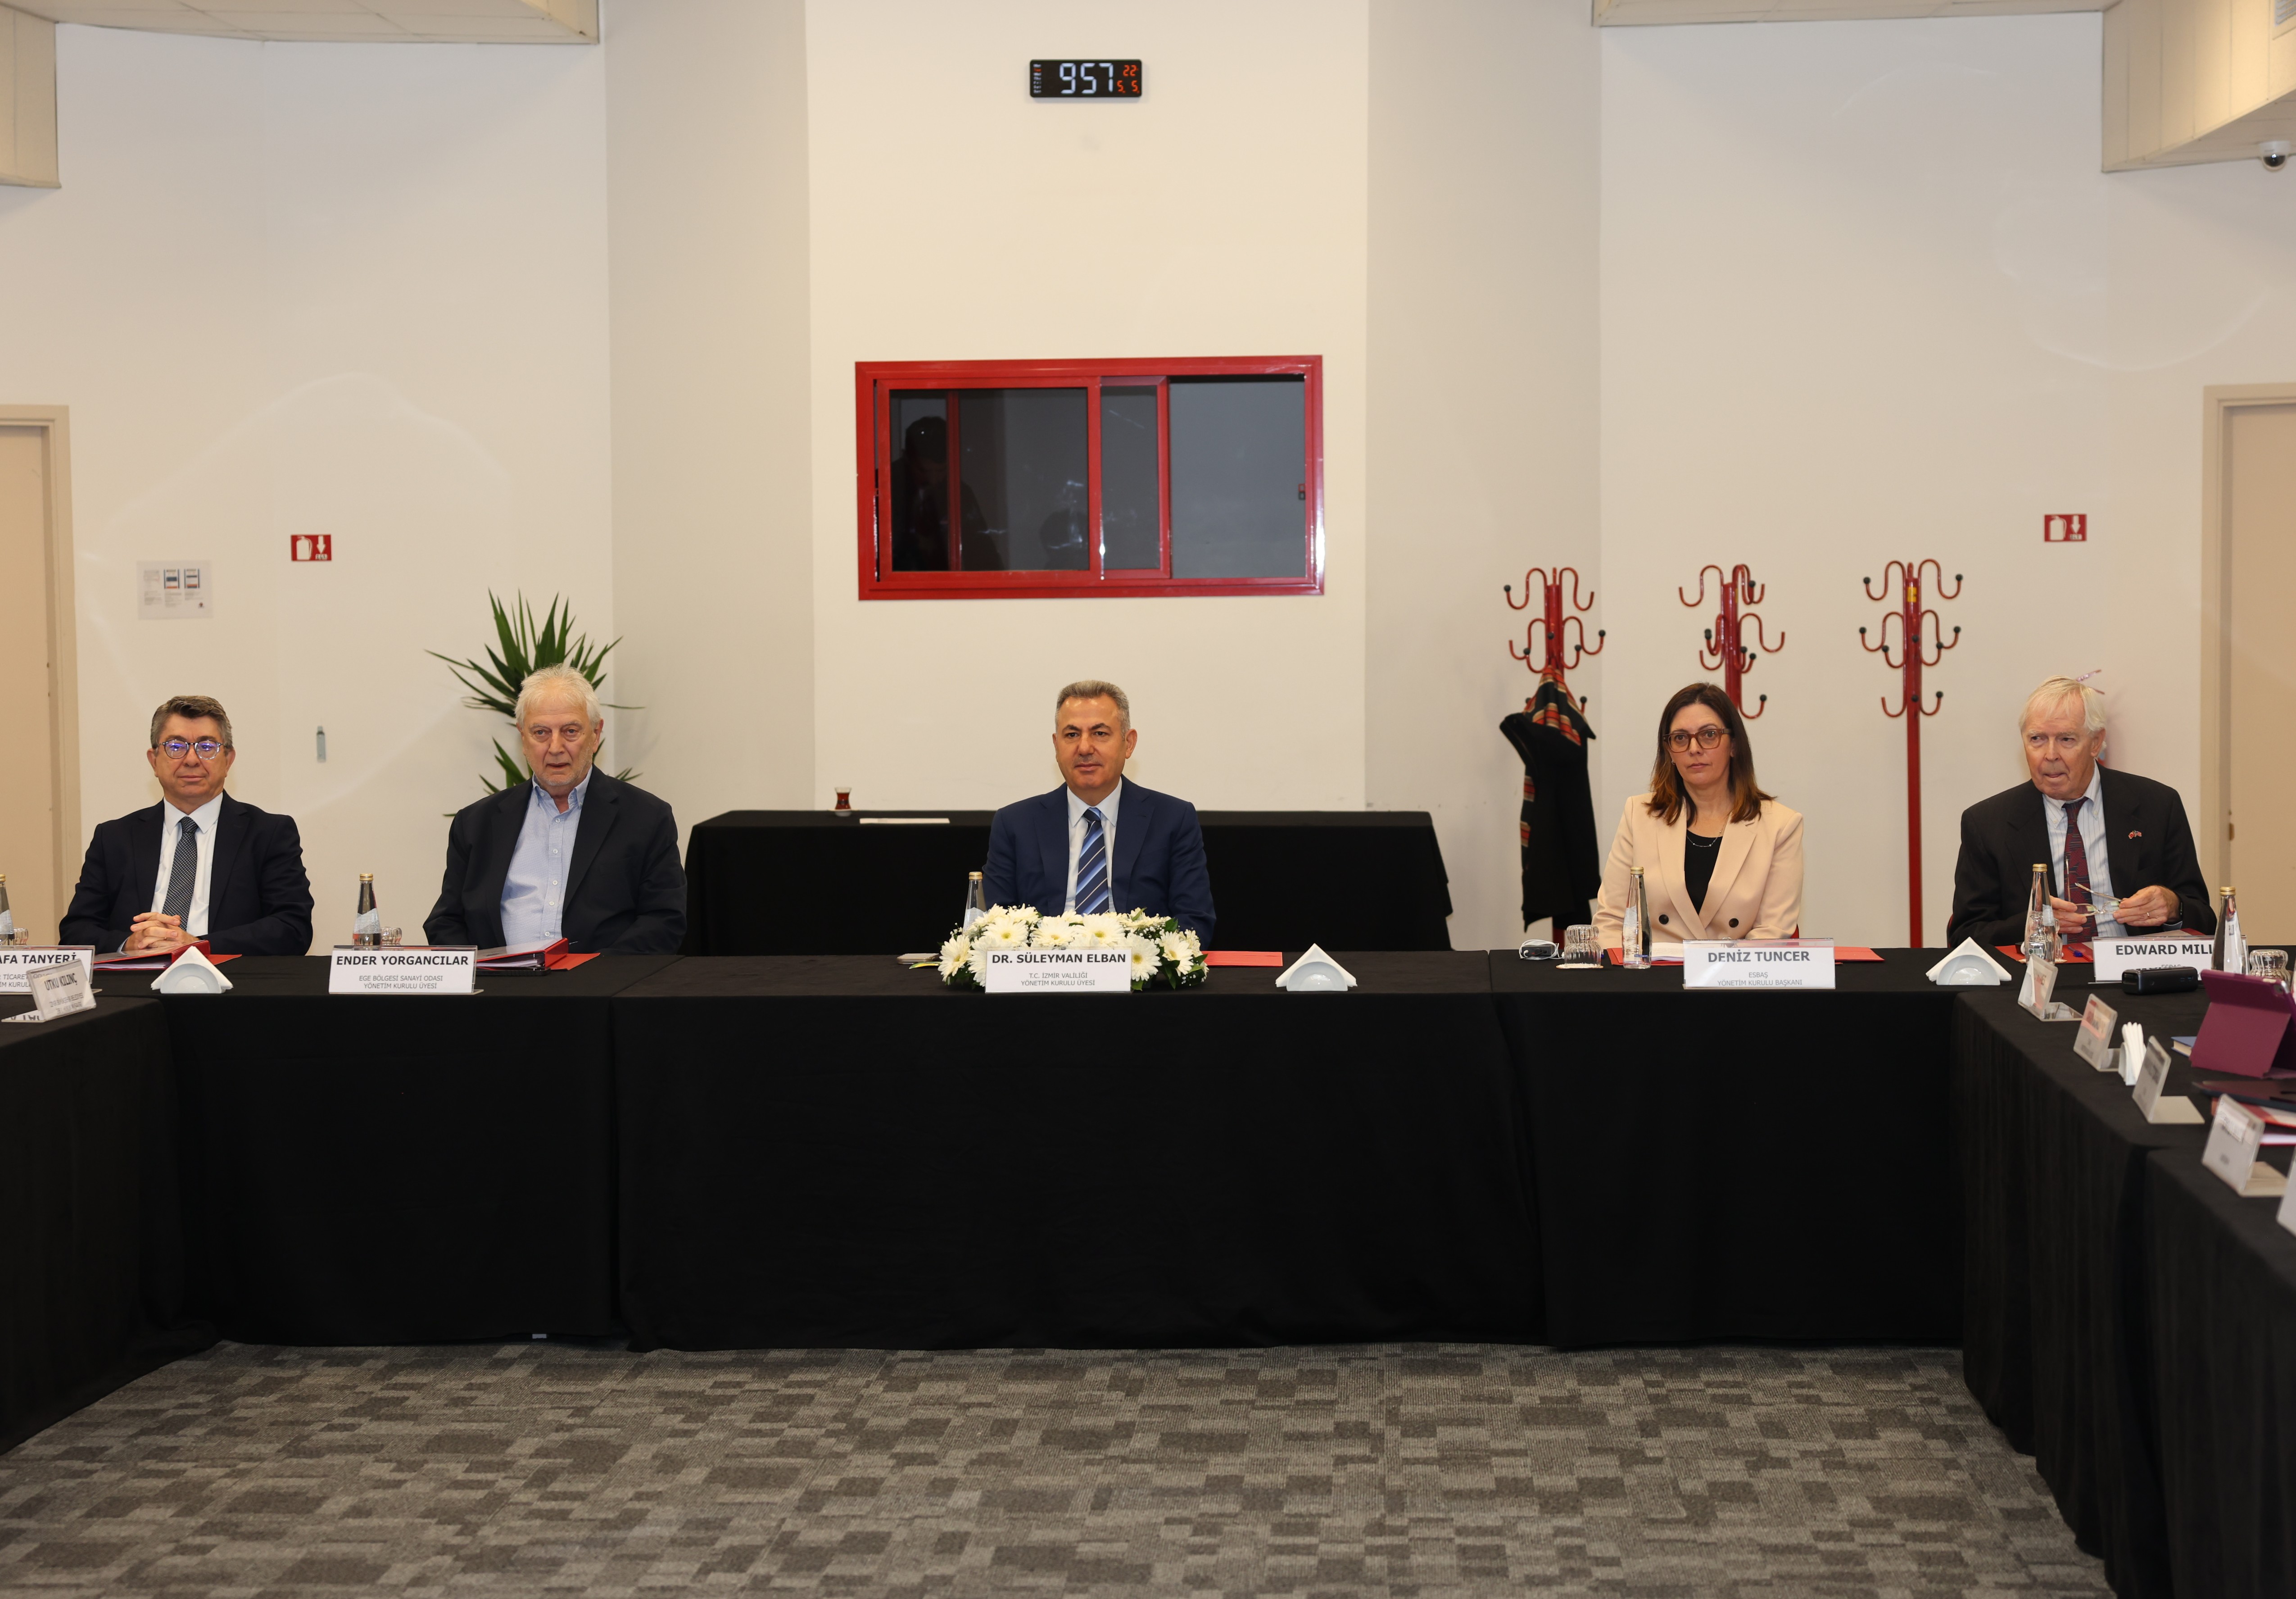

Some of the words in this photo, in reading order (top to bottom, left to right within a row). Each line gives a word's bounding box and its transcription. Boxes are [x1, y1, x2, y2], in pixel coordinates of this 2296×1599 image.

[1708, 949, 1751, 962] DENİZ
[1754, 951, 1810, 962] TUNCER
[2116, 945, 2177, 955] EDWARD
[22, 952, 77, 964] TANYERİ
[336, 956, 377, 965] ENDER
[381, 956, 468, 965] YORGANCILAR
[992, 954, 1012, 963] DR.
[1017, 952, 1082, 963] SÜLEYMAN
[1087, 954, 1126, 963] ELBAN
[44, 978, 59, 990] UTKU
